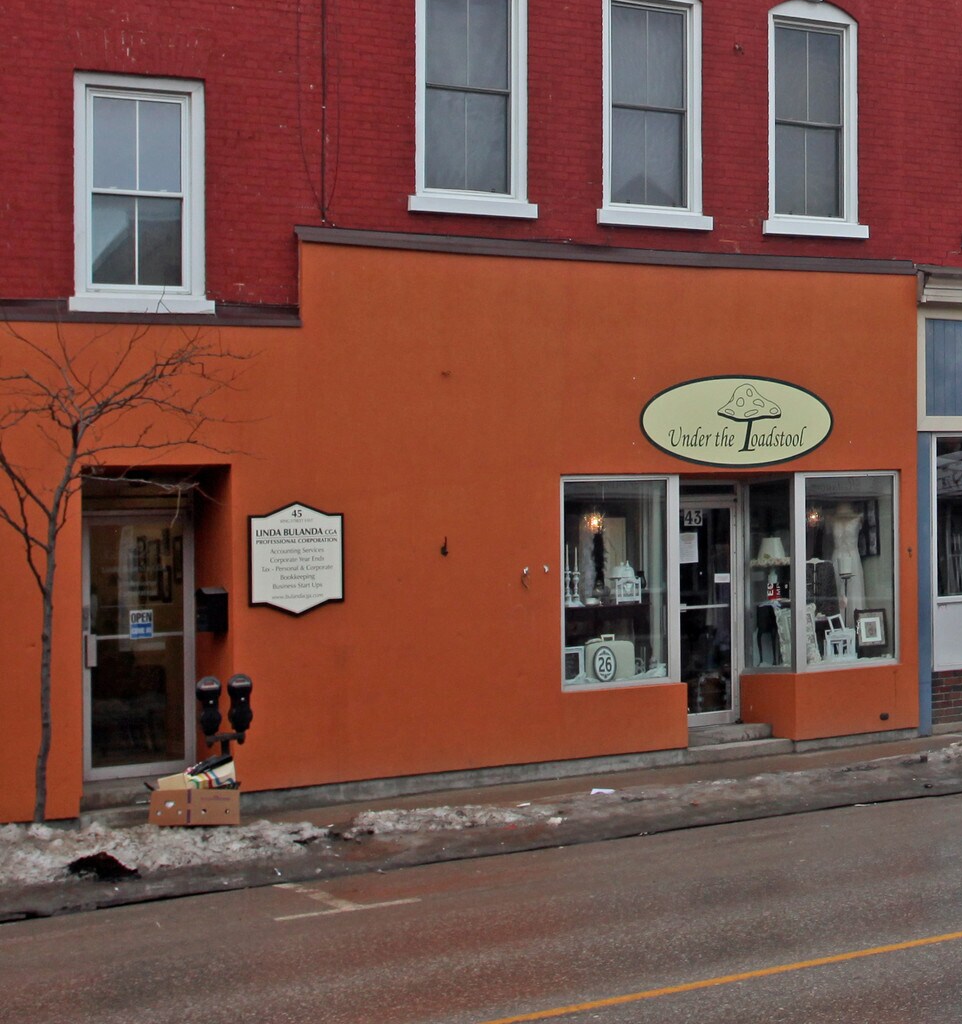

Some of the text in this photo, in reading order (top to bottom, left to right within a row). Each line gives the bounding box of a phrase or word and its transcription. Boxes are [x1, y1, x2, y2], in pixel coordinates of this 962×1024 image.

[668, 426, 712, 447] Under
[714, 426, 735, 446] the
[291, 509, 303, 518] 45
[684, 510, 702, 525] 43
[256, 529, 281, 537] LINDA
[283, 528, 323, 536] BULANDA
[131, 612, 152, 623] OPEN
[598, 657, 612, 672] 26
